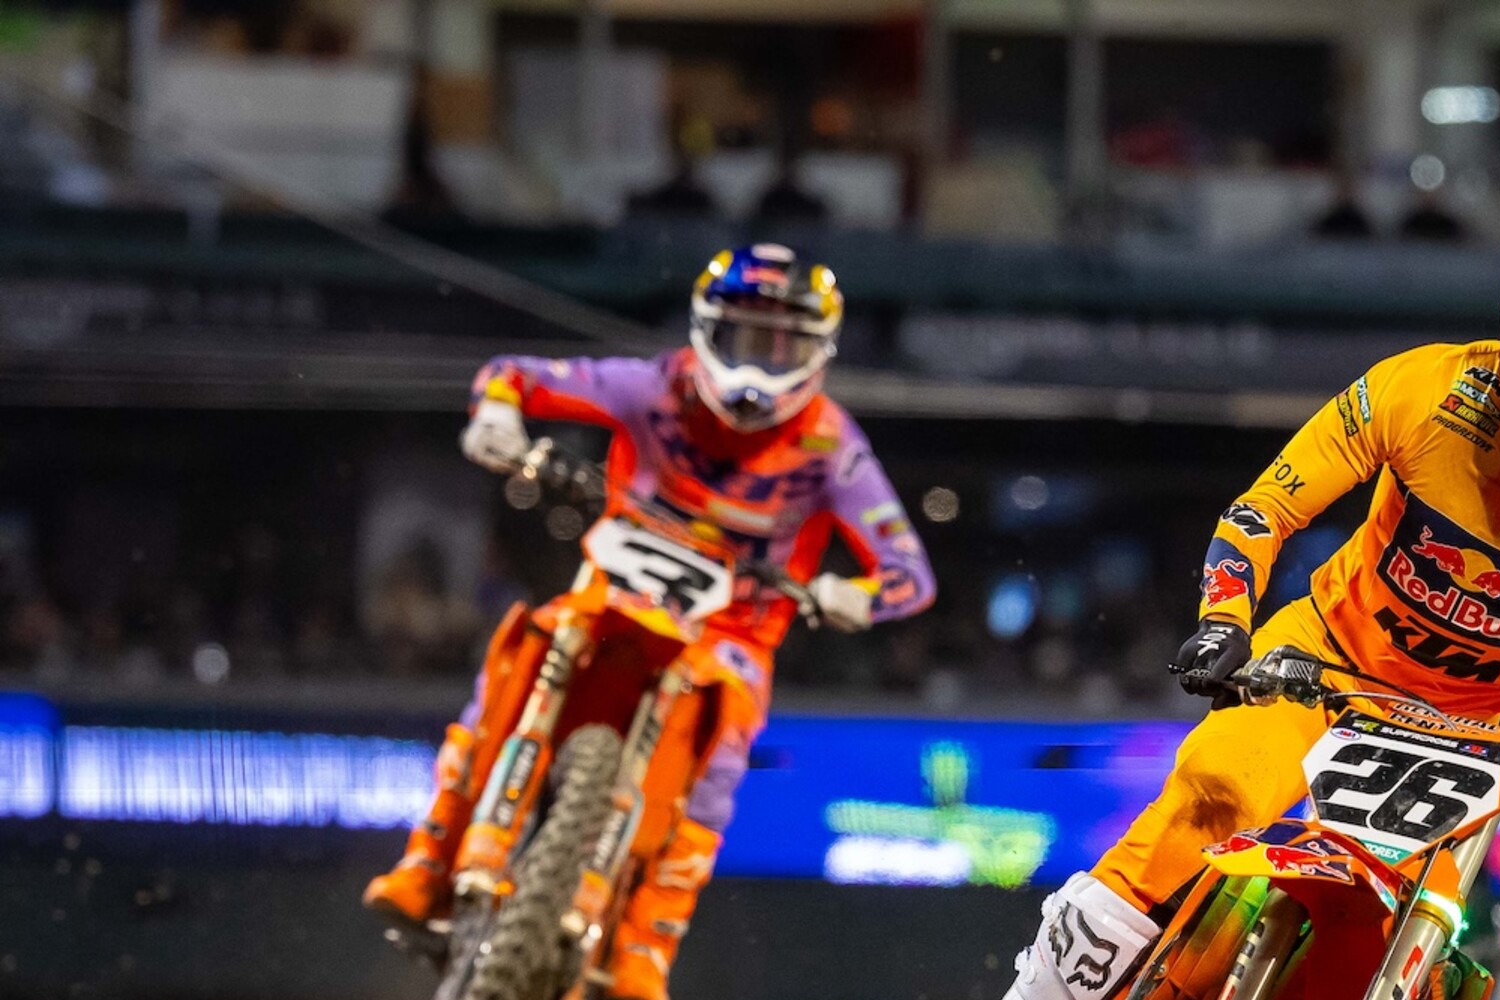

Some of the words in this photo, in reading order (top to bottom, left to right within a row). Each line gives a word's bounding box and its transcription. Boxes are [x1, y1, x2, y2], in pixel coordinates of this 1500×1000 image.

[603, 541, 716, 613] 3
[1386, 548, 1460, 620] Red
[1198, 626, 1233, 656] FOX
[1311, 742, 1497, 843] 26
